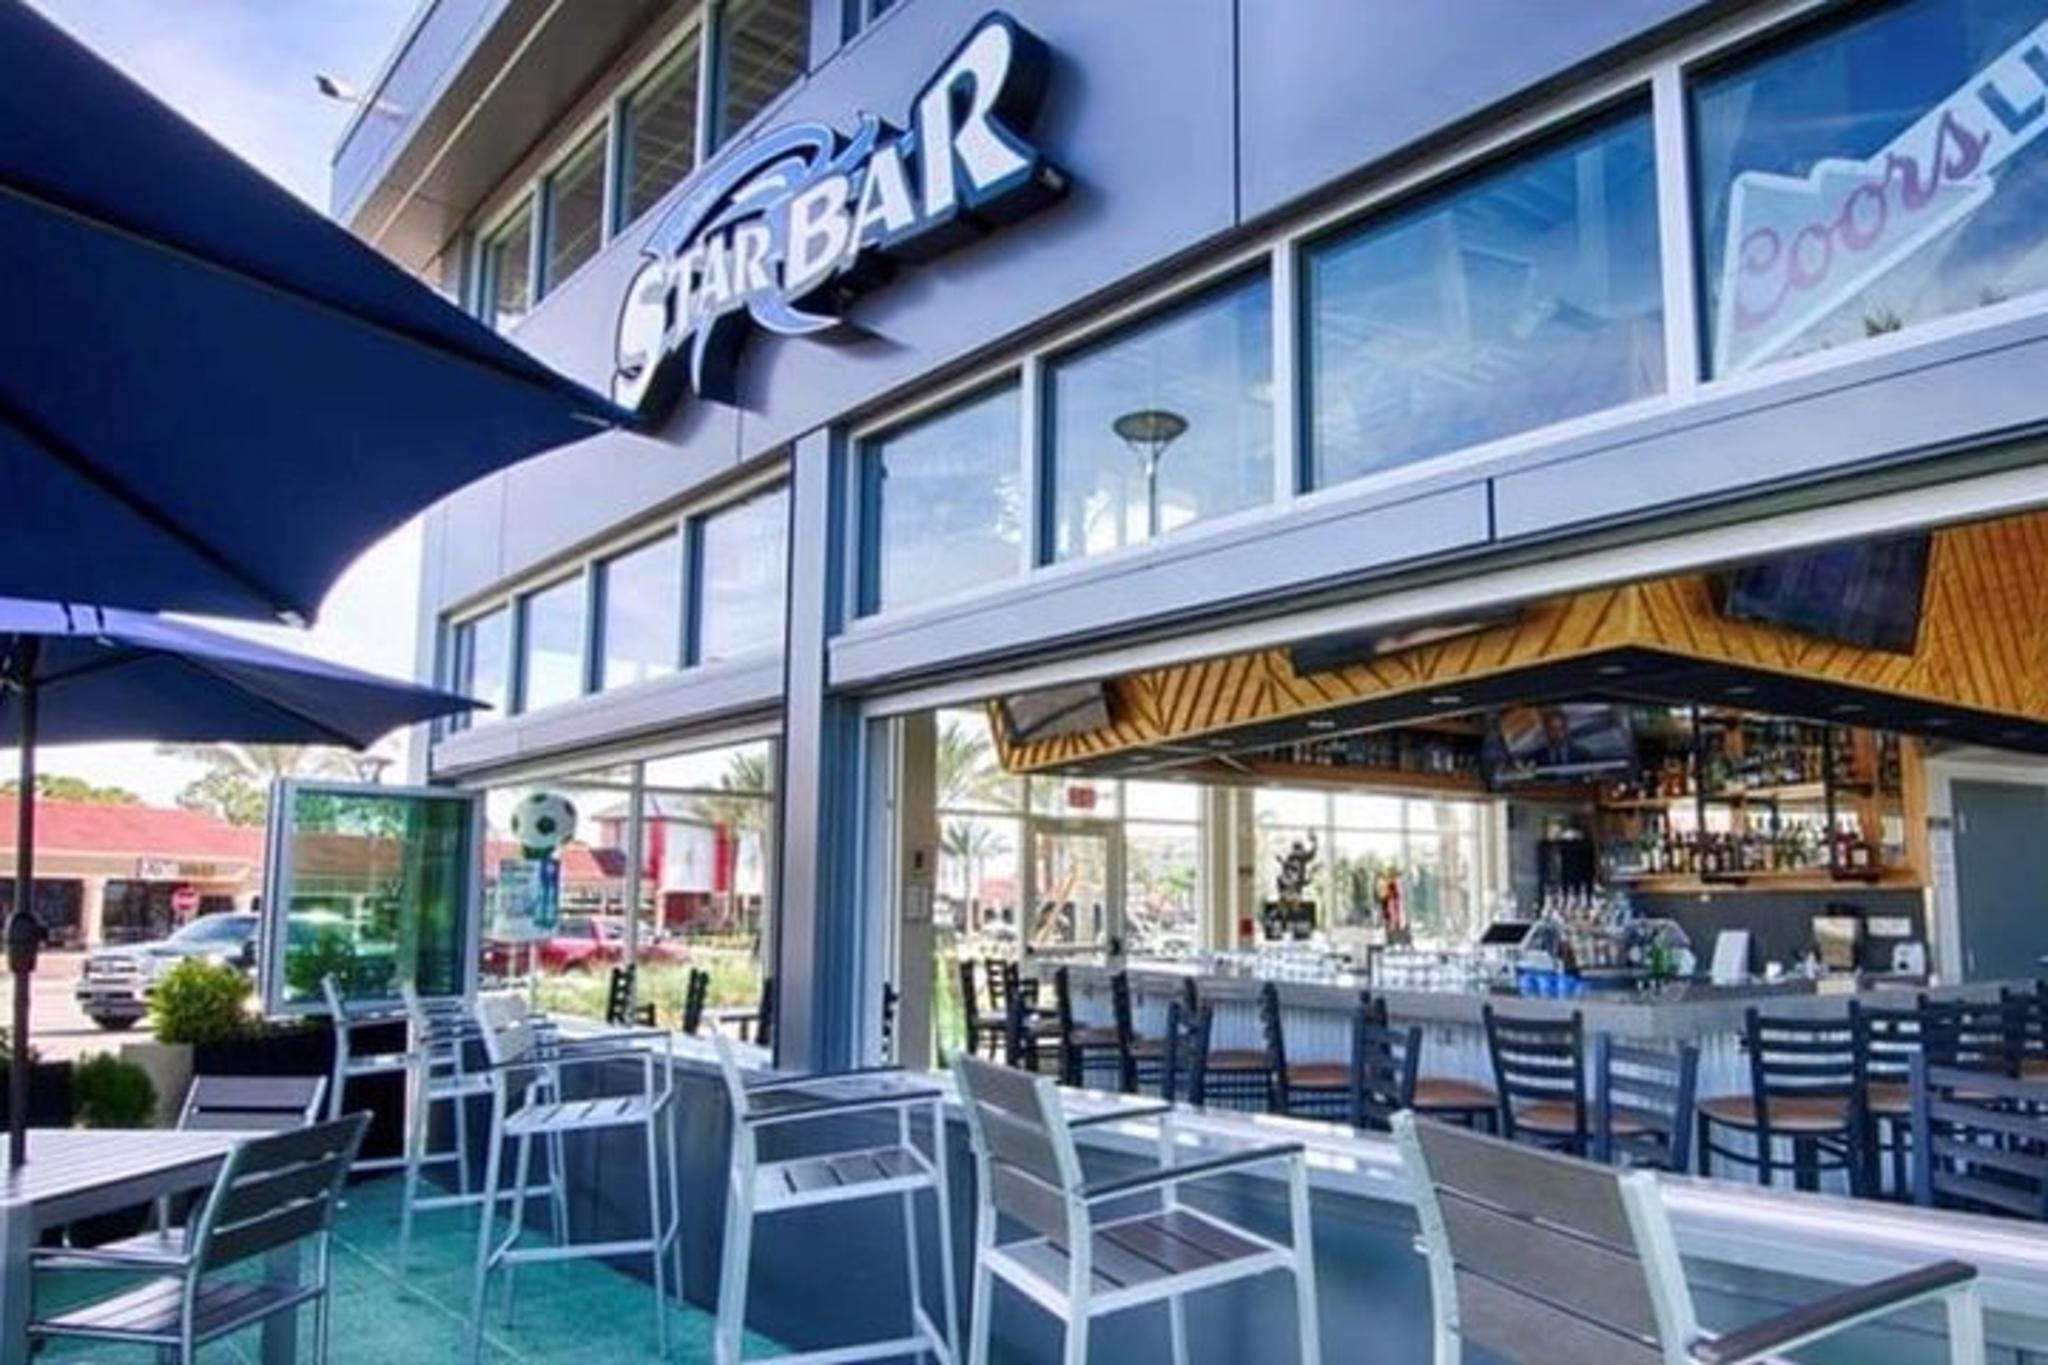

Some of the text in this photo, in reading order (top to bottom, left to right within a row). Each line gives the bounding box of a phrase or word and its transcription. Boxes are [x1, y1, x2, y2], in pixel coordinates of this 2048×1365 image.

[614, 22, 1030, 411] STAR BAR
[1734, 110, 1991, 332] Coors
